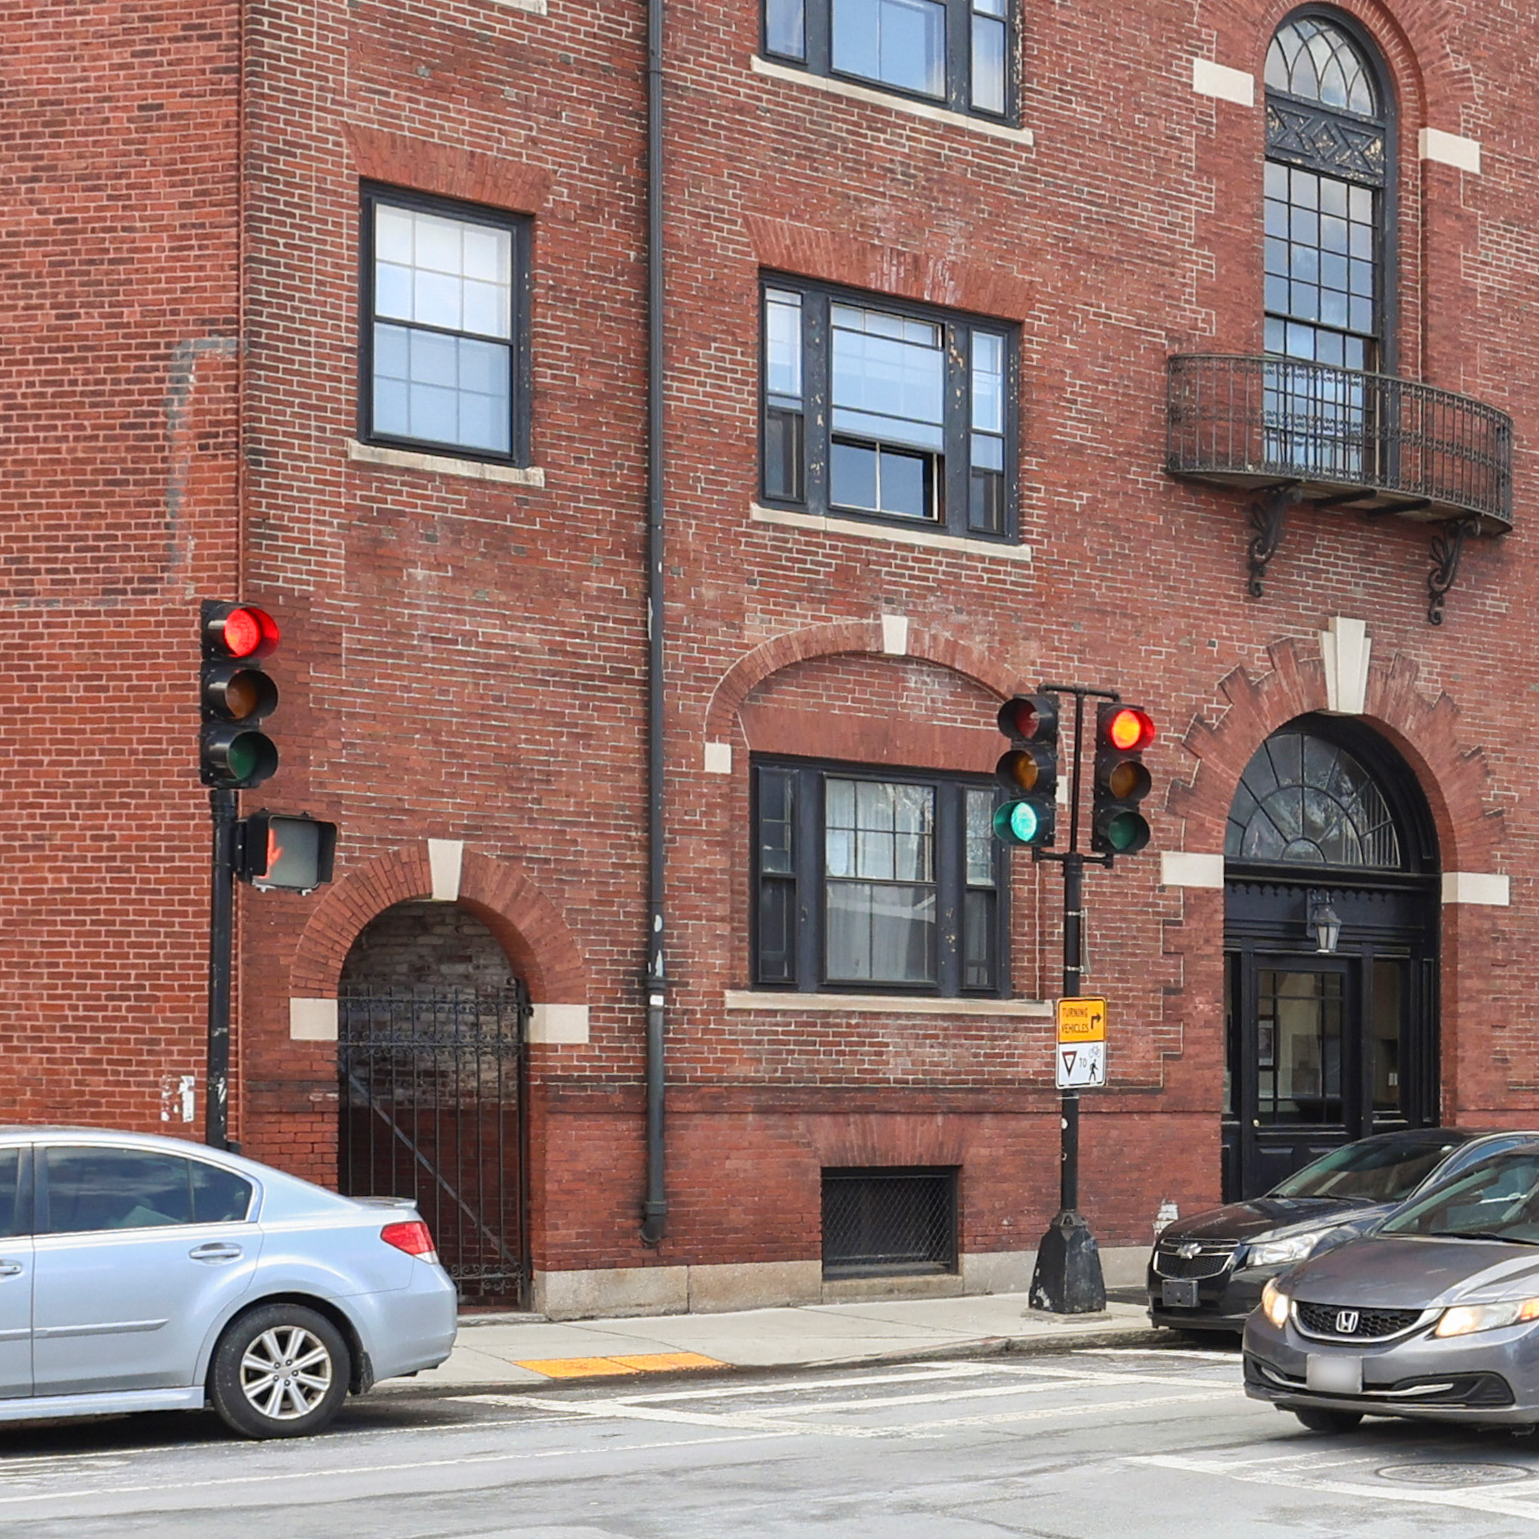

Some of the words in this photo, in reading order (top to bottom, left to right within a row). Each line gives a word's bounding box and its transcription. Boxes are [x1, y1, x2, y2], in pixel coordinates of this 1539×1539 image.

[1061, 1007, 1089, 1018] TURNING
[1061, 1023, 1090, 1034] VEHICLES
[1079, 1057, 1088, 1068] TO
